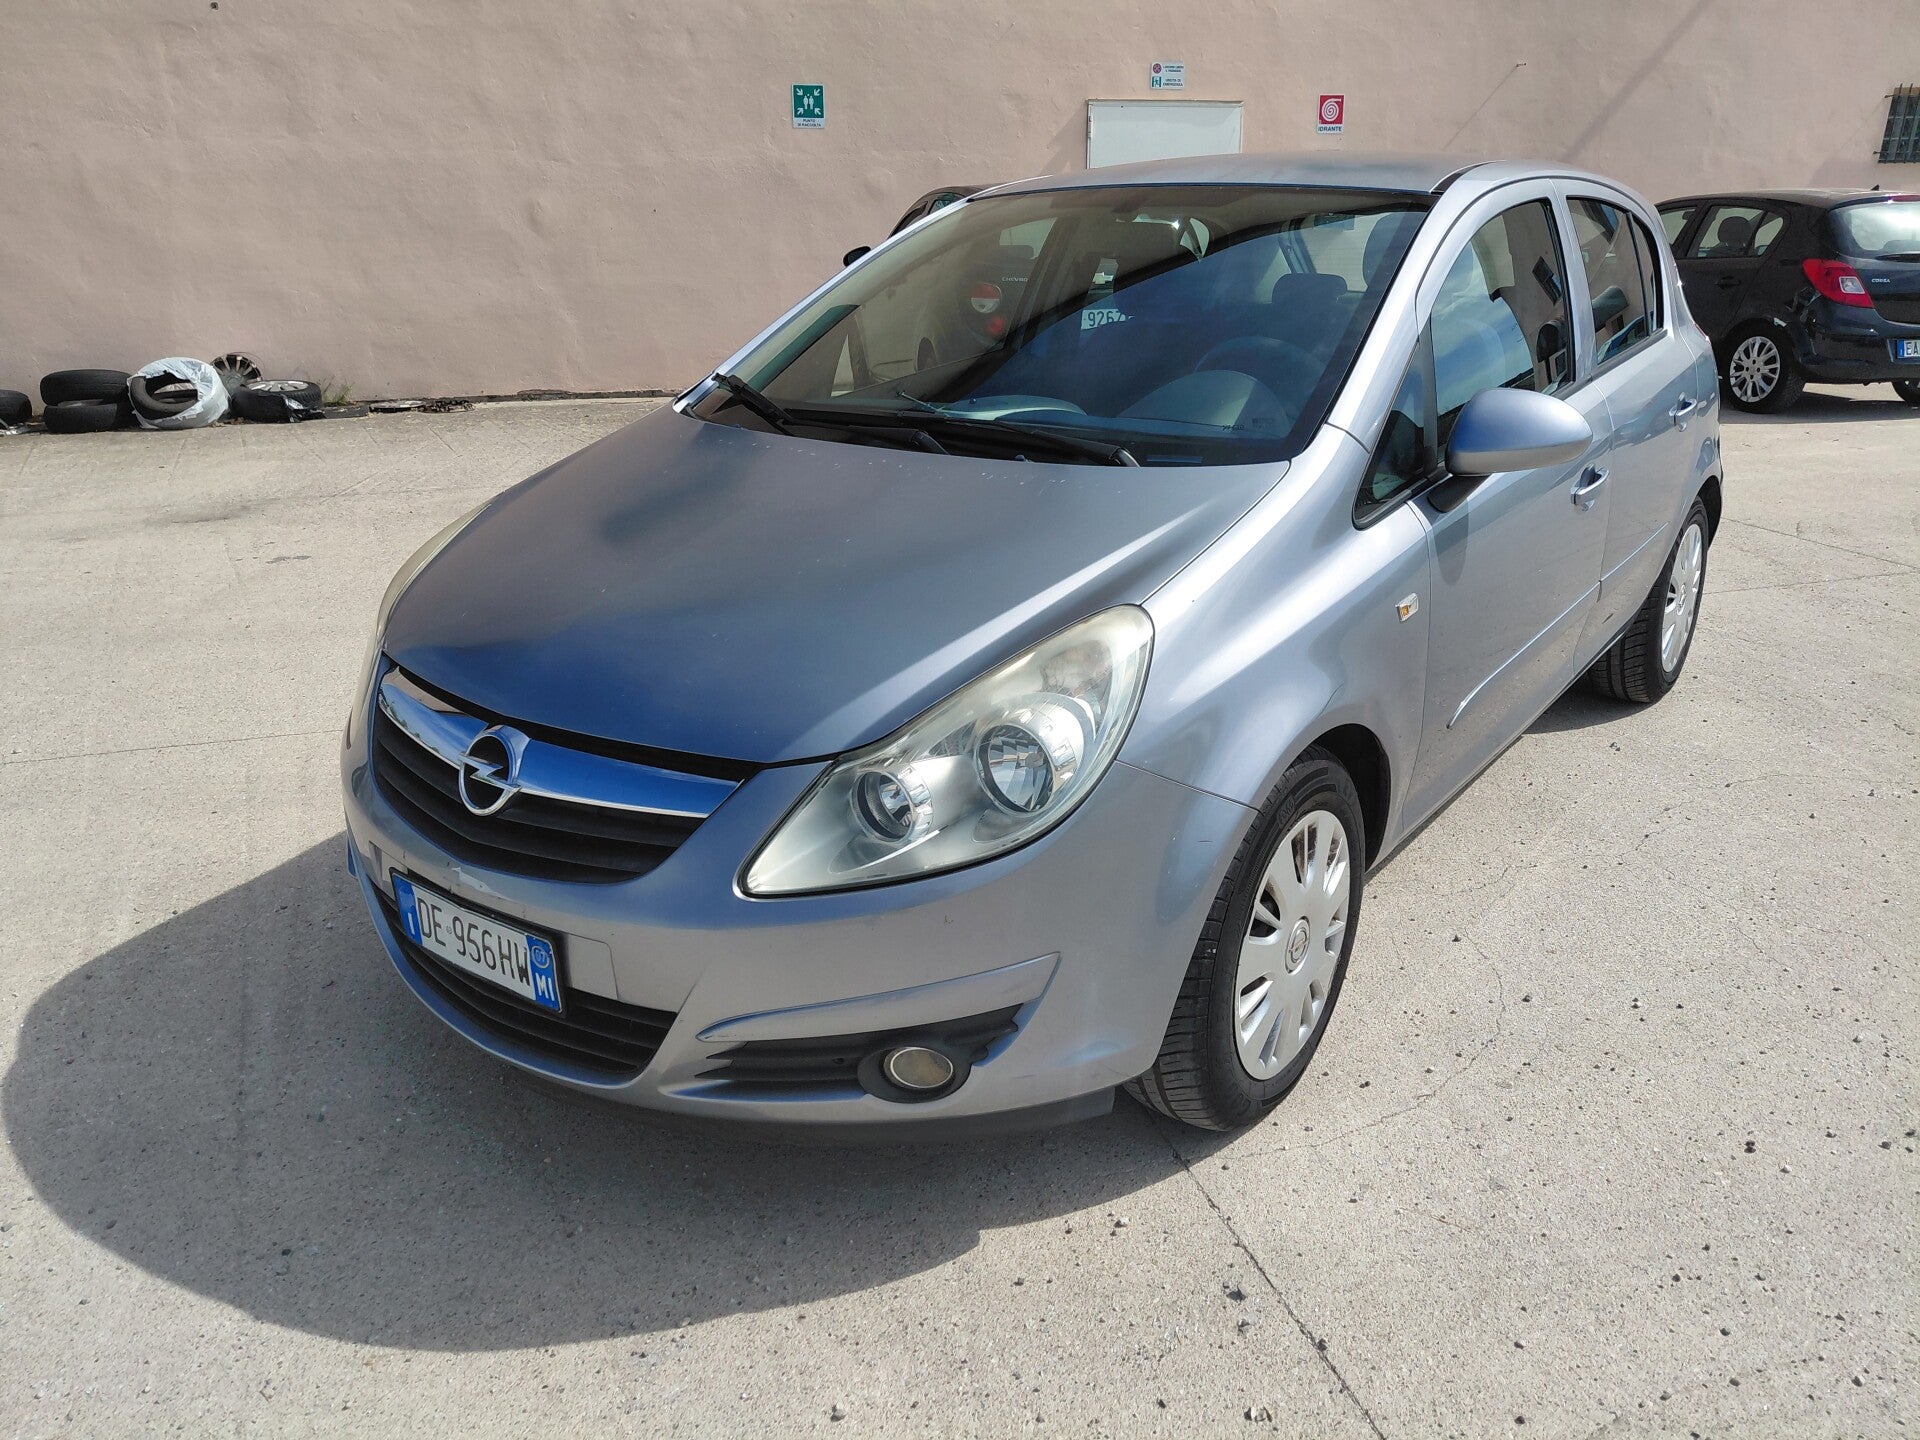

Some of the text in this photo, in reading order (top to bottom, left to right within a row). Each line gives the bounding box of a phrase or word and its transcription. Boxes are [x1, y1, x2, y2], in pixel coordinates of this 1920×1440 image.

[1906, 341, 1918, 355] EA
[416, 897, 447, 947] DE
[452, 915, 531, 987] 956HW
[535, 972, 555, 1002] MI
